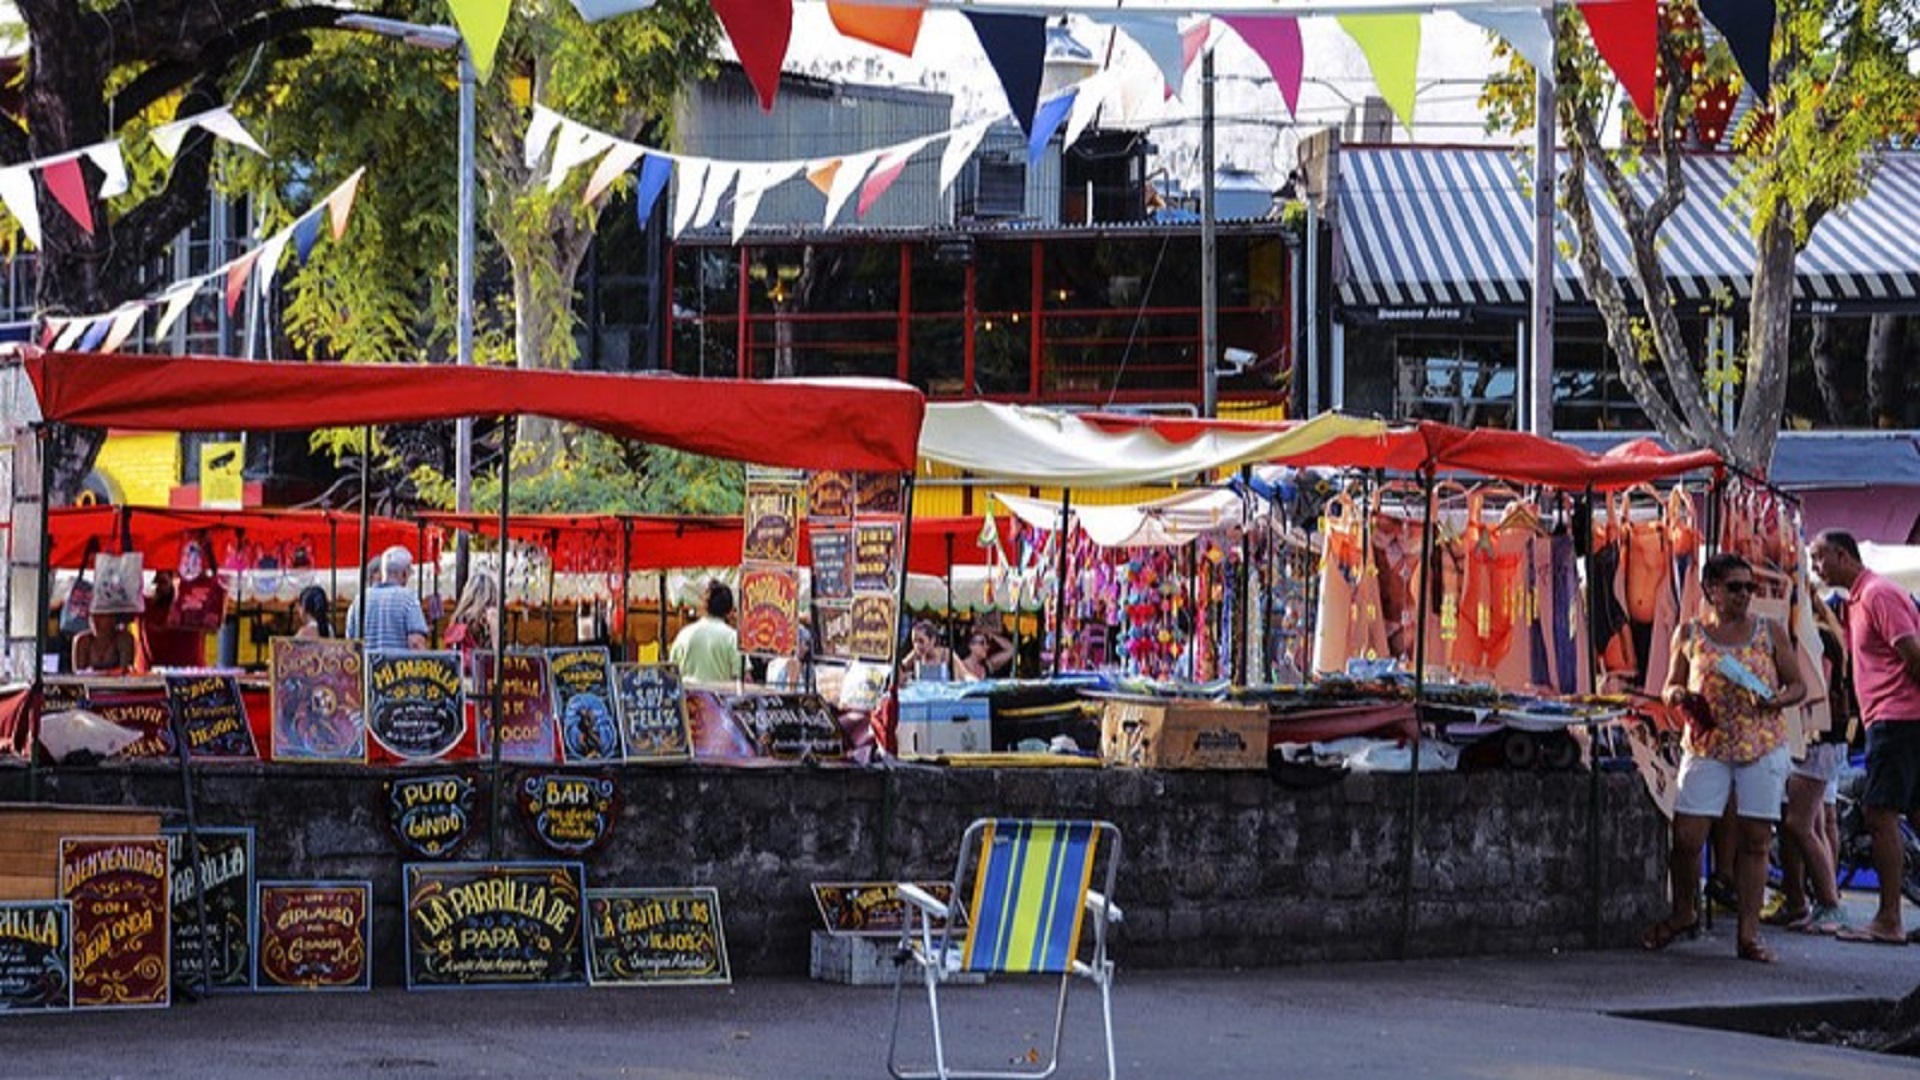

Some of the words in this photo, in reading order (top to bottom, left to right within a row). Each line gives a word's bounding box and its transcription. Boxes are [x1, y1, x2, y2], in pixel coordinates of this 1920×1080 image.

[1378, 306, 1424, 320] Buenos
[1427, 306, 1460, 319] Aires
[189, 718, 239, 746] MEJOR
[404, 781, 458, 806] PUTO
[546, 781, 589, 805] BAR
[408, 813, 460, 838] LINDO
[63, 845, 164, 896] BIENVENIDOS
[416, 897, 454, 937] LA
[447, 875, 546, 920] PARRILLA
[545, 898, 576, 934] DE
[112, 909, 153, 940] ONDA
[593, 914, 615, 938] LA
